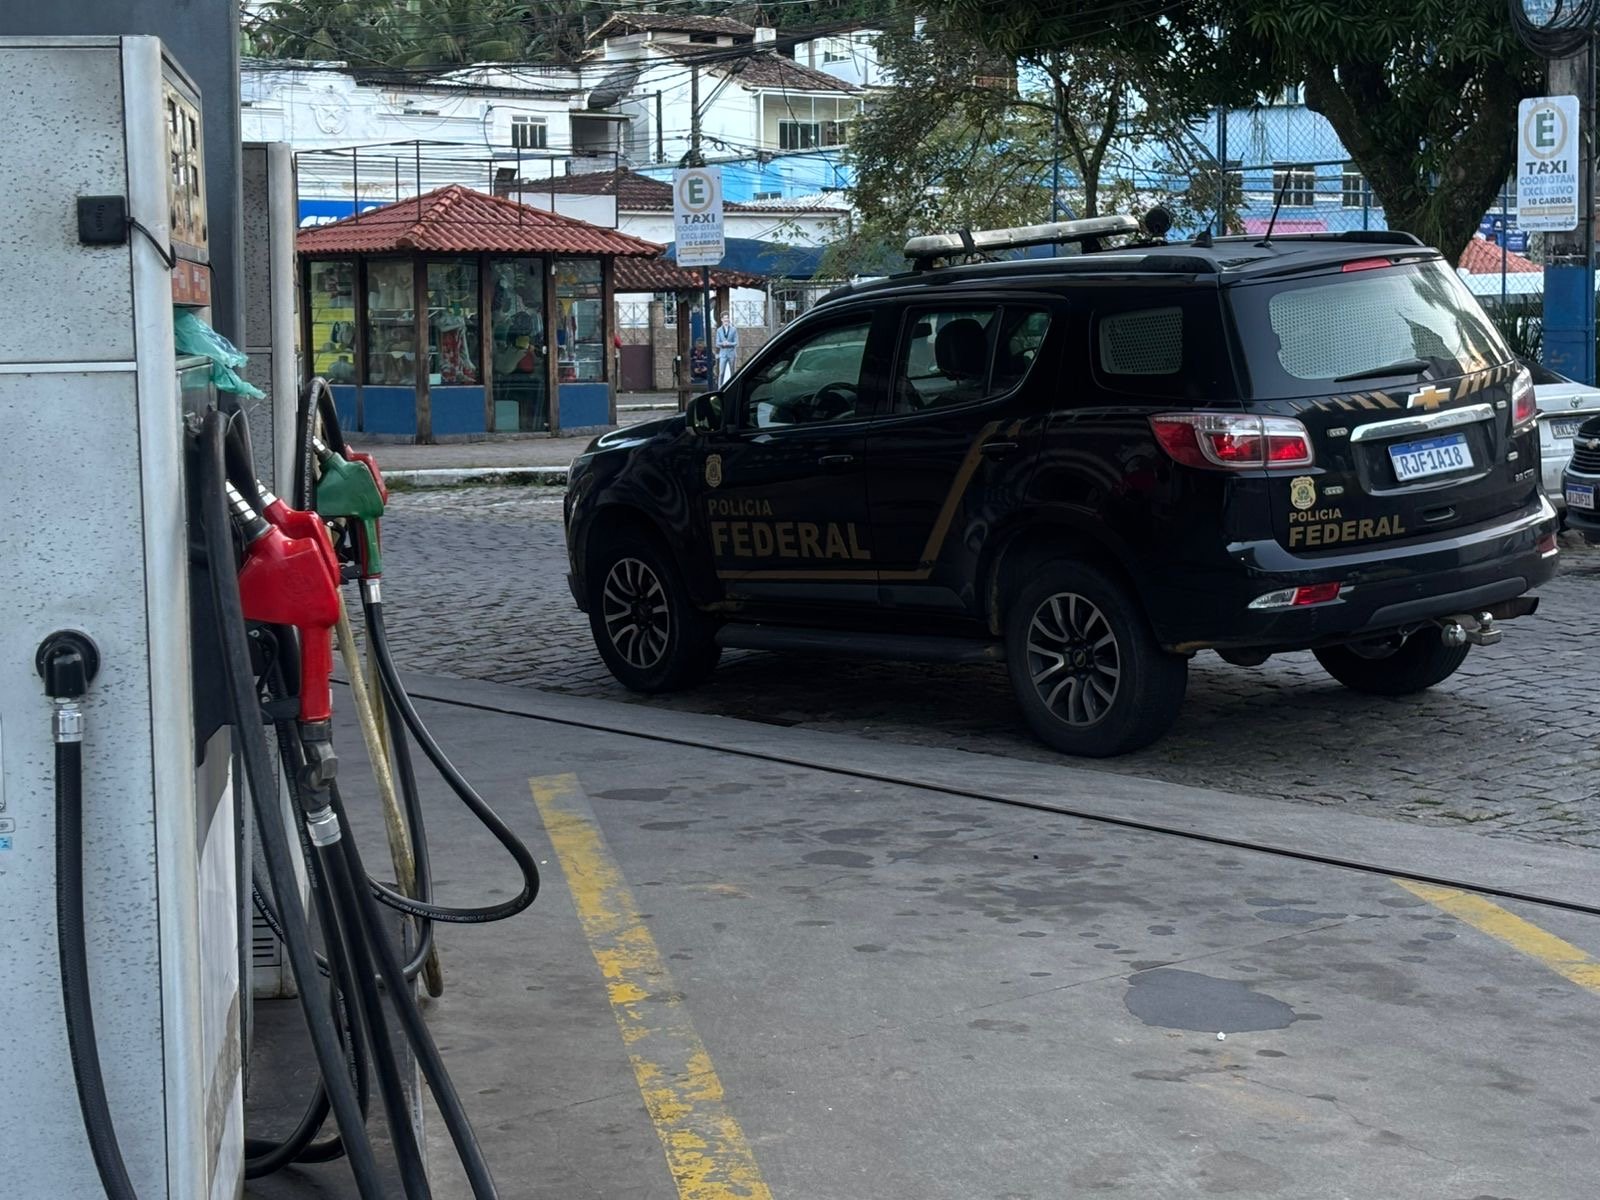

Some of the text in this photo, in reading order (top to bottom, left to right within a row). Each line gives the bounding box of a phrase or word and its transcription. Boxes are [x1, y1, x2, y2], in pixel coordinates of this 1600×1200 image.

[1535, 111, 1555, 147] E
[1525, 160, 1567, 175] TAXI
[688, 178, 705, 204] E
[1523, 185, 1574, 196] EXCLUSIVO
[1528, 196, 1573, 205] 10 CARROS
[682, 213, 715, 225] TAXI
[1400, 446, 1464, 475] RJF1A18
[708, 498, 773, 516] POLICIA
[1289, 508, 1342, 523] POLICIA
[1289, 514, 1406, 547] FEDERAL
[711, 521, 871, 560] FEDERAL
